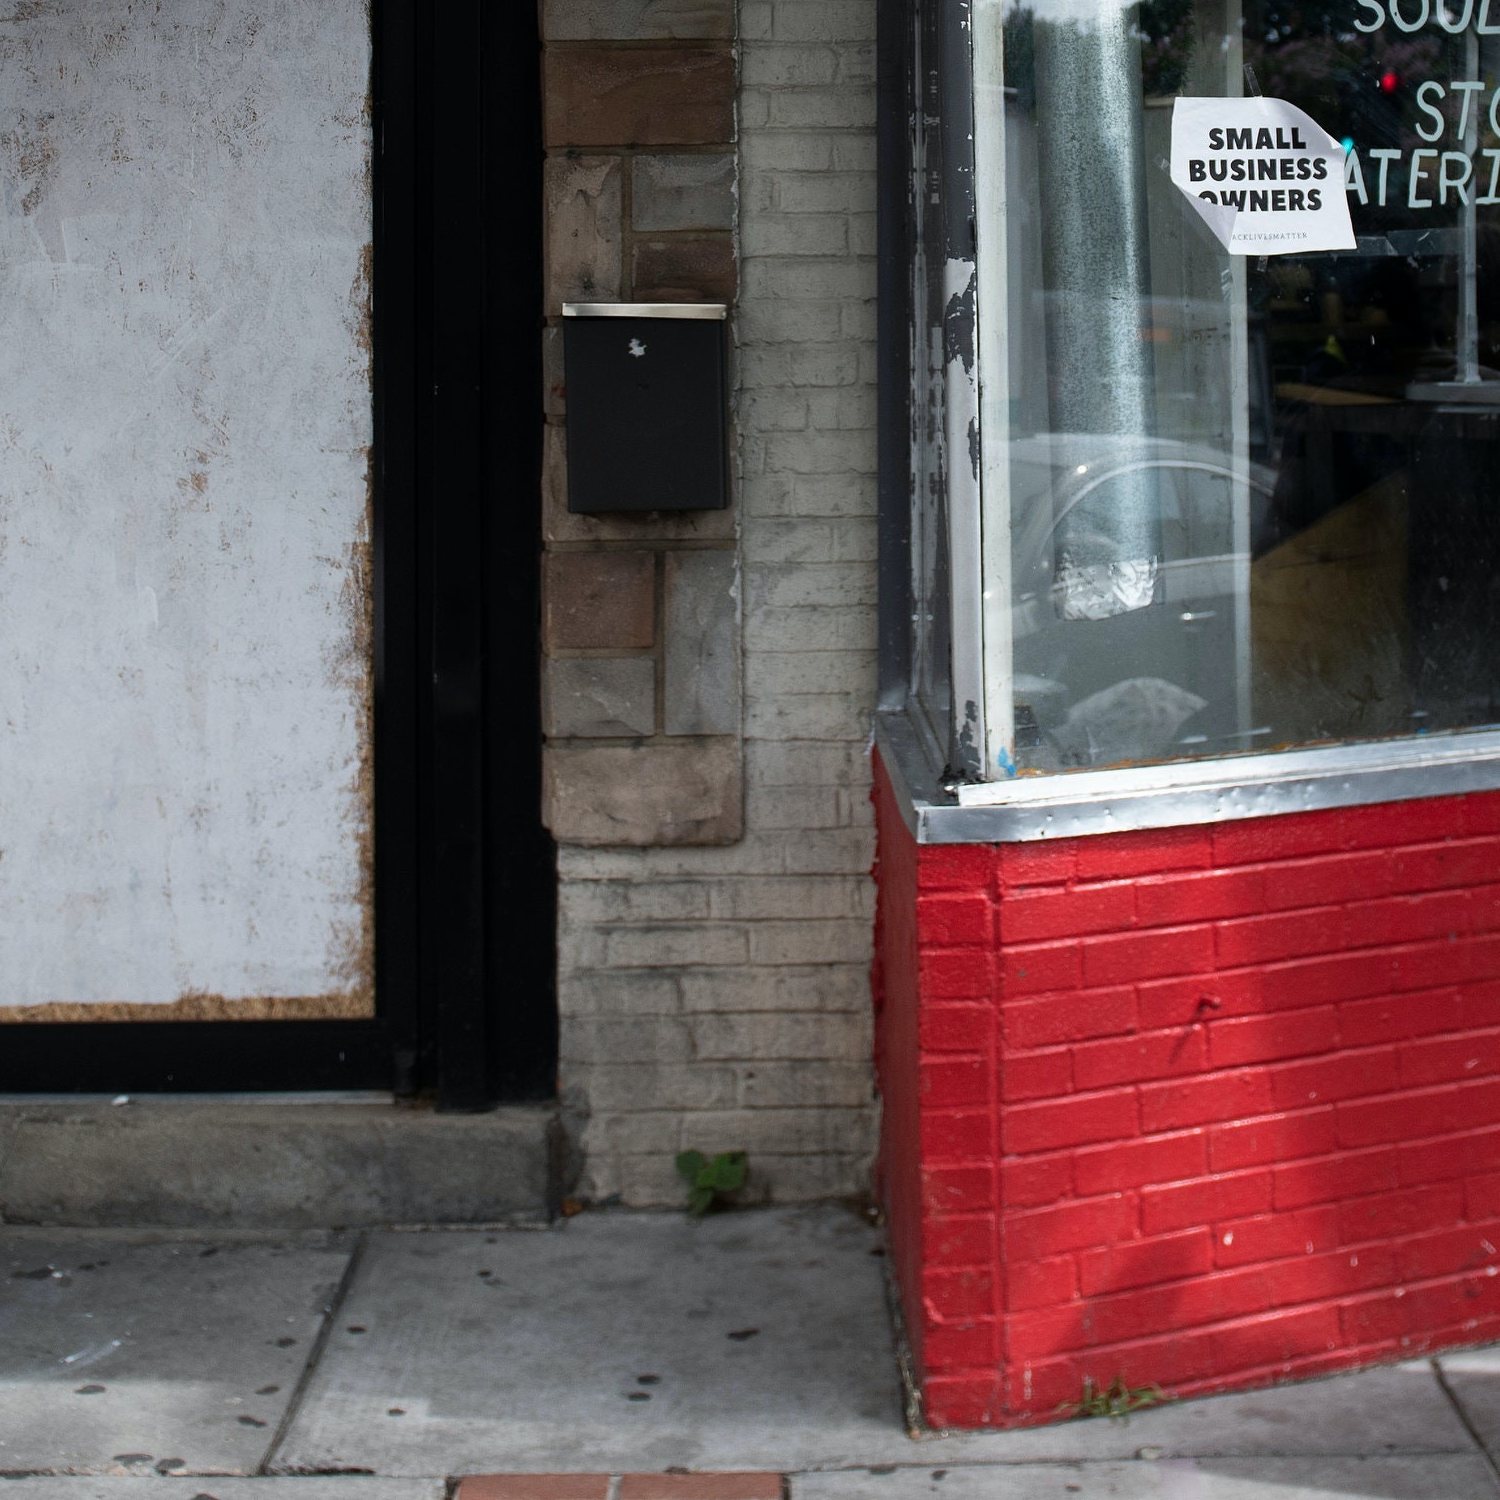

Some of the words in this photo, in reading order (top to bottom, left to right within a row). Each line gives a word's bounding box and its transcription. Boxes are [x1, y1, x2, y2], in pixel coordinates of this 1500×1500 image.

[1208, 127, 1307, 150] SMALL
[1189, 157, 1328, 182] BUSINESS
[1232, 232, 1308, 242] ACKLIVESMATTER
